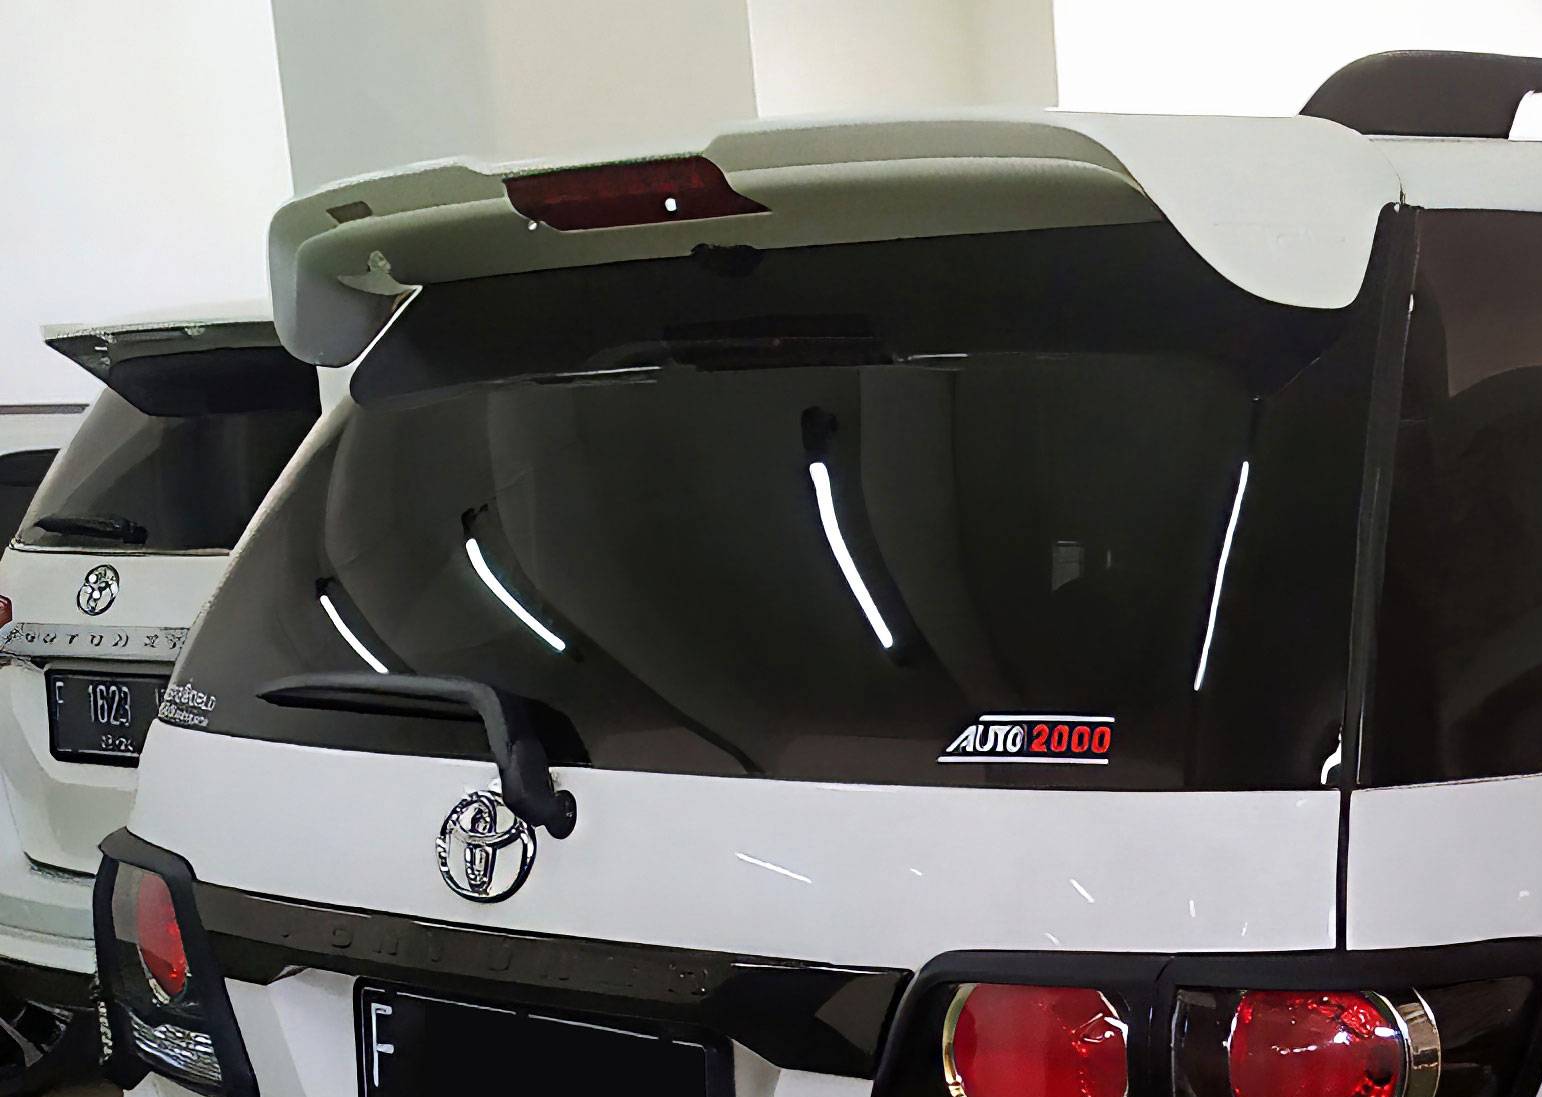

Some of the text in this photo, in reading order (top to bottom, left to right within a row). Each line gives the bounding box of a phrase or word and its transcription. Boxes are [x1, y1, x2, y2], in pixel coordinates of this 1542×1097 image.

[88, 684, 131, 727] 1623
[946, 723, 1111, 754] AUTO 2000
[370, 1002, 395, 1088] F
